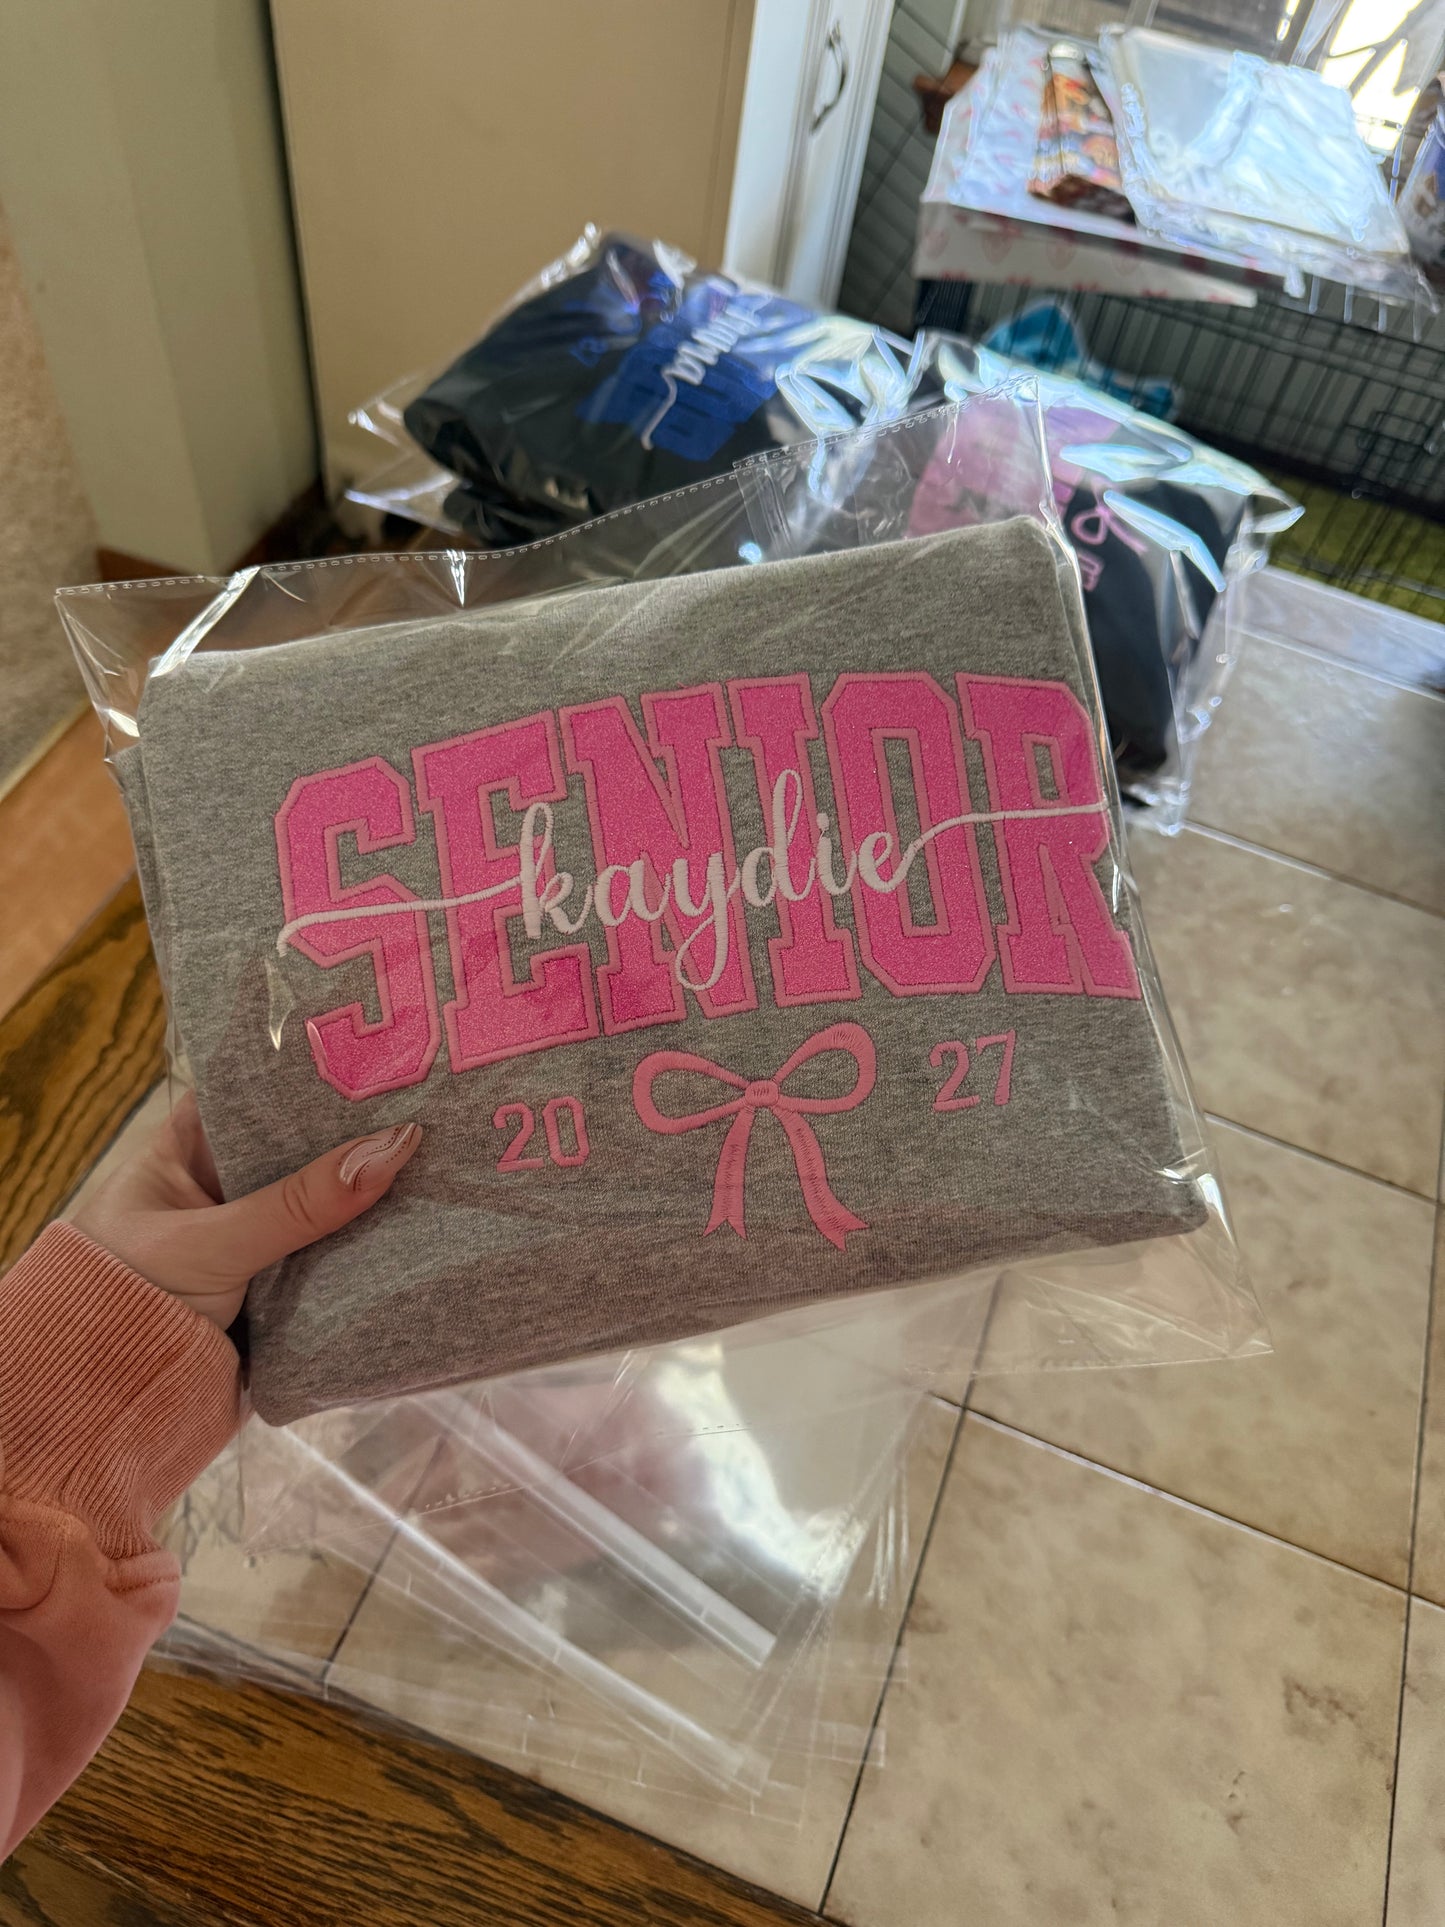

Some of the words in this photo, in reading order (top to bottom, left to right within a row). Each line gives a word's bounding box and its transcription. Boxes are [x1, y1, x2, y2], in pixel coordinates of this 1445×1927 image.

[274, 671, 1144, 1102] SENIOR
[493, 1097, 590, 1173] 20
[930, 1029, 1017, 1113] 27
